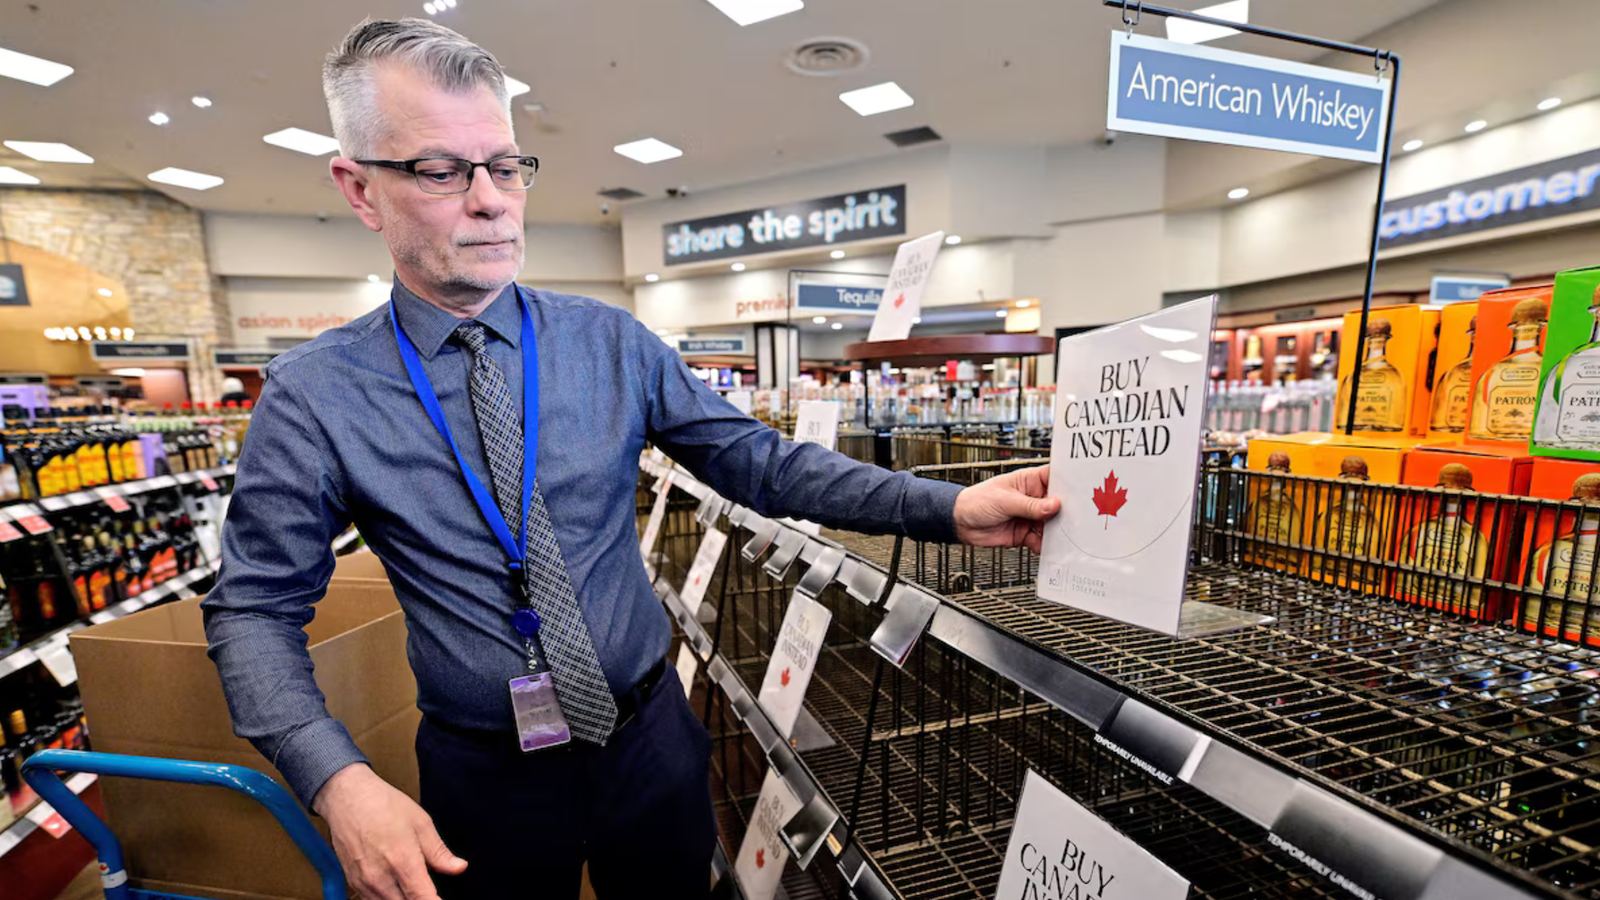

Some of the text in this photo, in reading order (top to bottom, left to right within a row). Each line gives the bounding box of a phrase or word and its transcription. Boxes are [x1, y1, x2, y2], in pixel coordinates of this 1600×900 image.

[1126, 61, 1375, 141] American Whiskey
[1380, 163, 1600, 239] customer
[667, 191, 898, 257] share the spirit
[238, 312, 293, 328] asian
[836, 288, 881, 307] Tequila
[1099, 356, 1150, 394] BUY
[1064, 385, 1189, 430] CANADIAN
[1070, 424, 1171, 459] INSTEAD
[1093, 732, 1175, 786] TEMPORARILY UNAVAILABLE
[1060, 838, 1115, 898] BUY
[1266, 832, 1331, 877] TEMPORARILY
